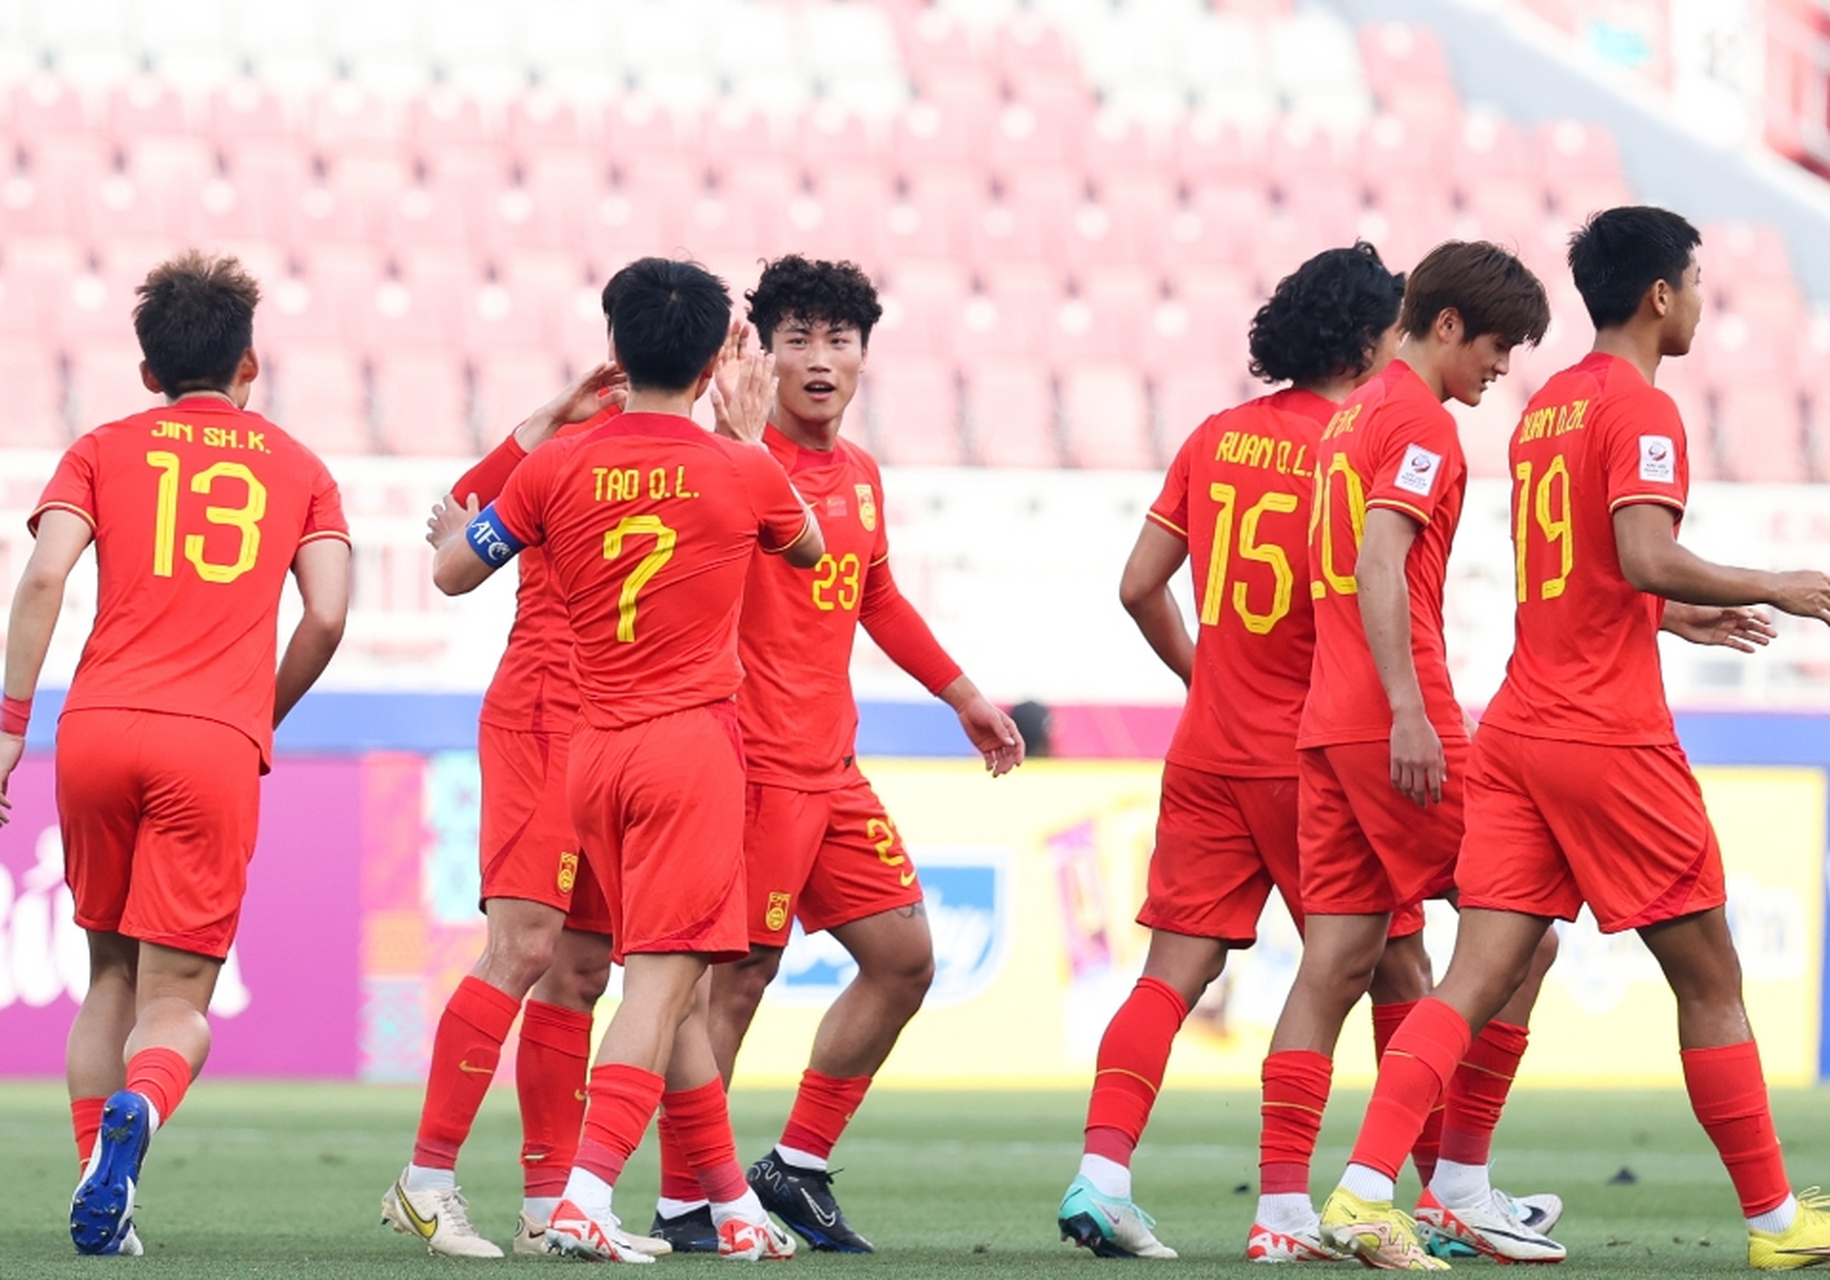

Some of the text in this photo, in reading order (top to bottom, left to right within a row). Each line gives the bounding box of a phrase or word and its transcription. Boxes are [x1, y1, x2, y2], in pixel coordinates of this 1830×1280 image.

[151, 421, 193, 443] JIN
[1215, 431, 1275, 469] RUAN
[592, 467, 639, 501] TAO
[146, 450, 267, 583] 13
[471, 520, 513, 561] AFC
[1516, 454, 1574, 603] 19
[603, 515, 677, 643] 7
[812, 553, 860, 610] 23
[1201, 482, 1298, 635] 15
[866, 817, 906, 867] 2
